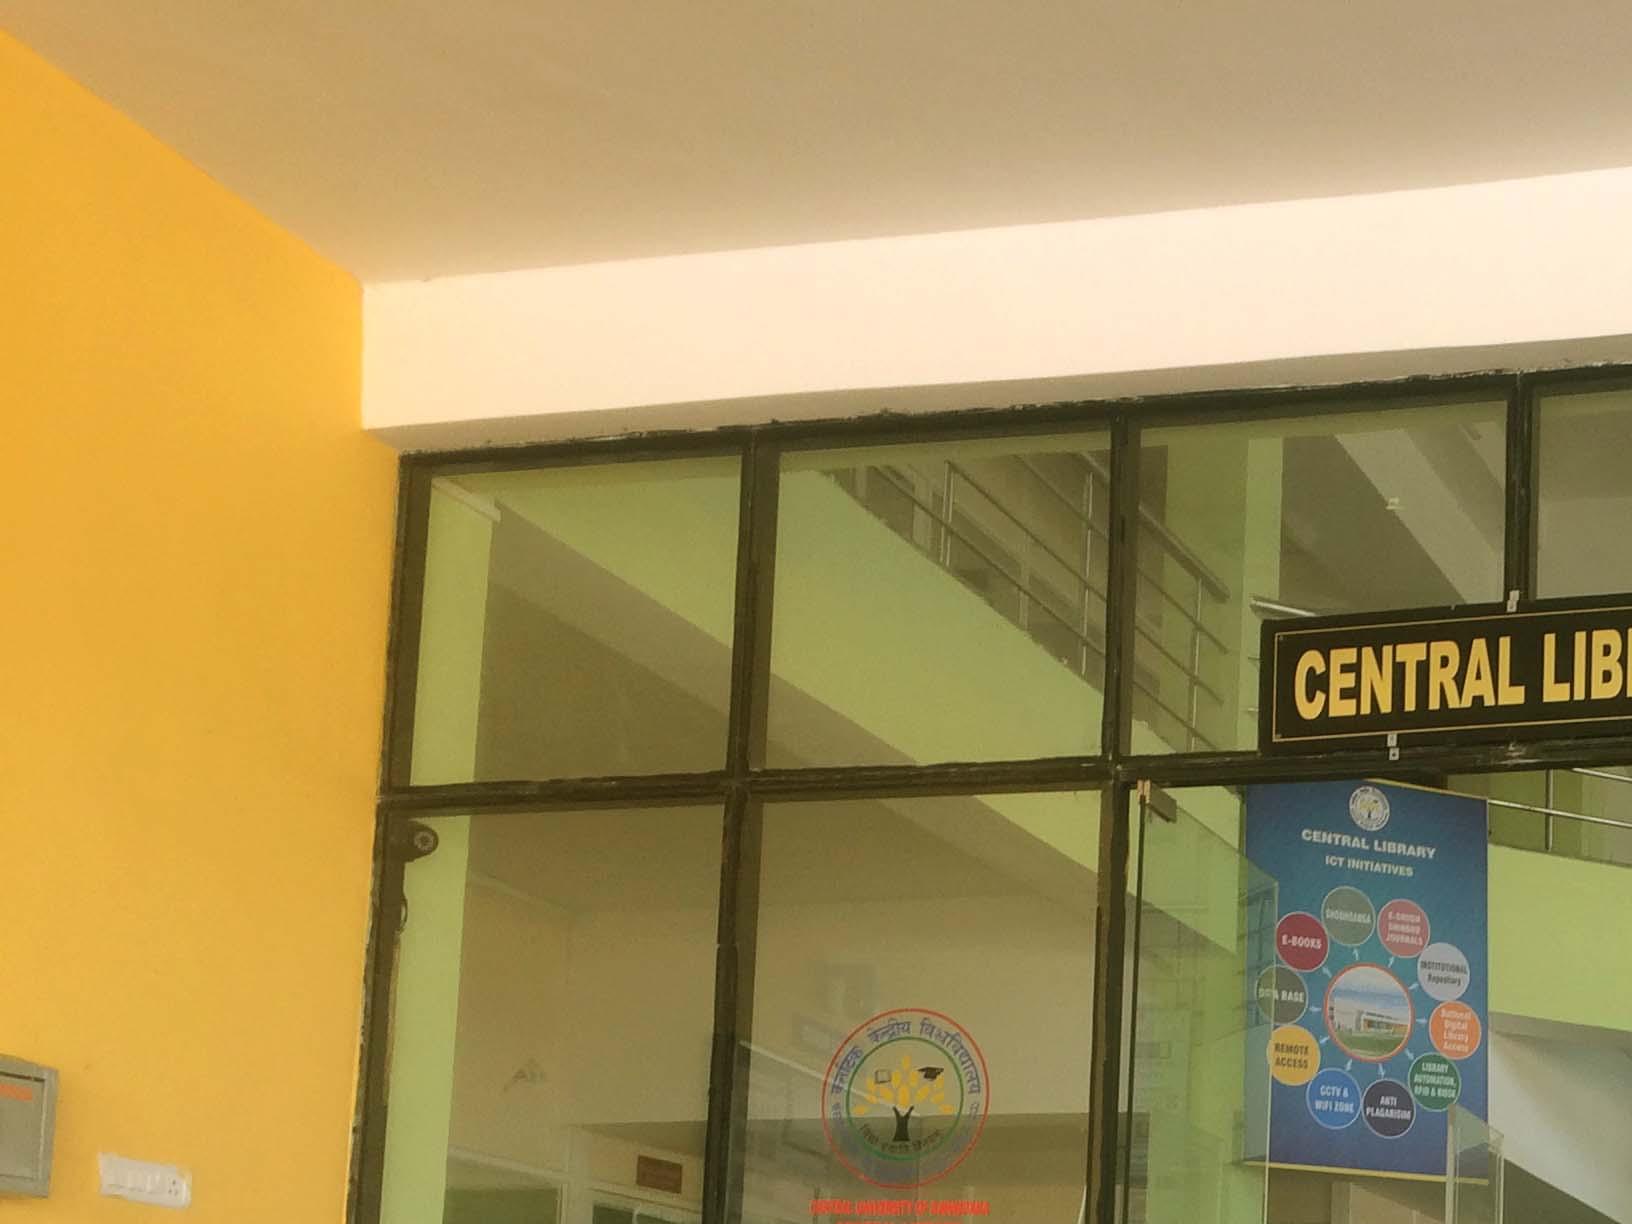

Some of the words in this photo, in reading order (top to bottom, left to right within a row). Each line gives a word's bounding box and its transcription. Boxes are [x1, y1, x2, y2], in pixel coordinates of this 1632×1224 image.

[1294, 636, 1525, 720] CENTRAL
[1301, 828, 1370, 850] CENTRAL
[1373, 839, 1436, 859] LIBRARY
[1325, 855, 1345, 867] ICT
[1347, 857, 1414, 877] INITIATIVES
[1281, 933, 1322, 950] E-BOOKS
[1281, 988, 1305, 1003] BASE
[1274, 1042, 1309, 1057] REMOTE
[1274, 1057, 1309, 1070] ACCESS
[1421, 1061, 1449, 1074] LIBRARY
[1320, 1085, 1342, 1097] CCTV
[1379, 1095, 1398, 1107] ANTI
